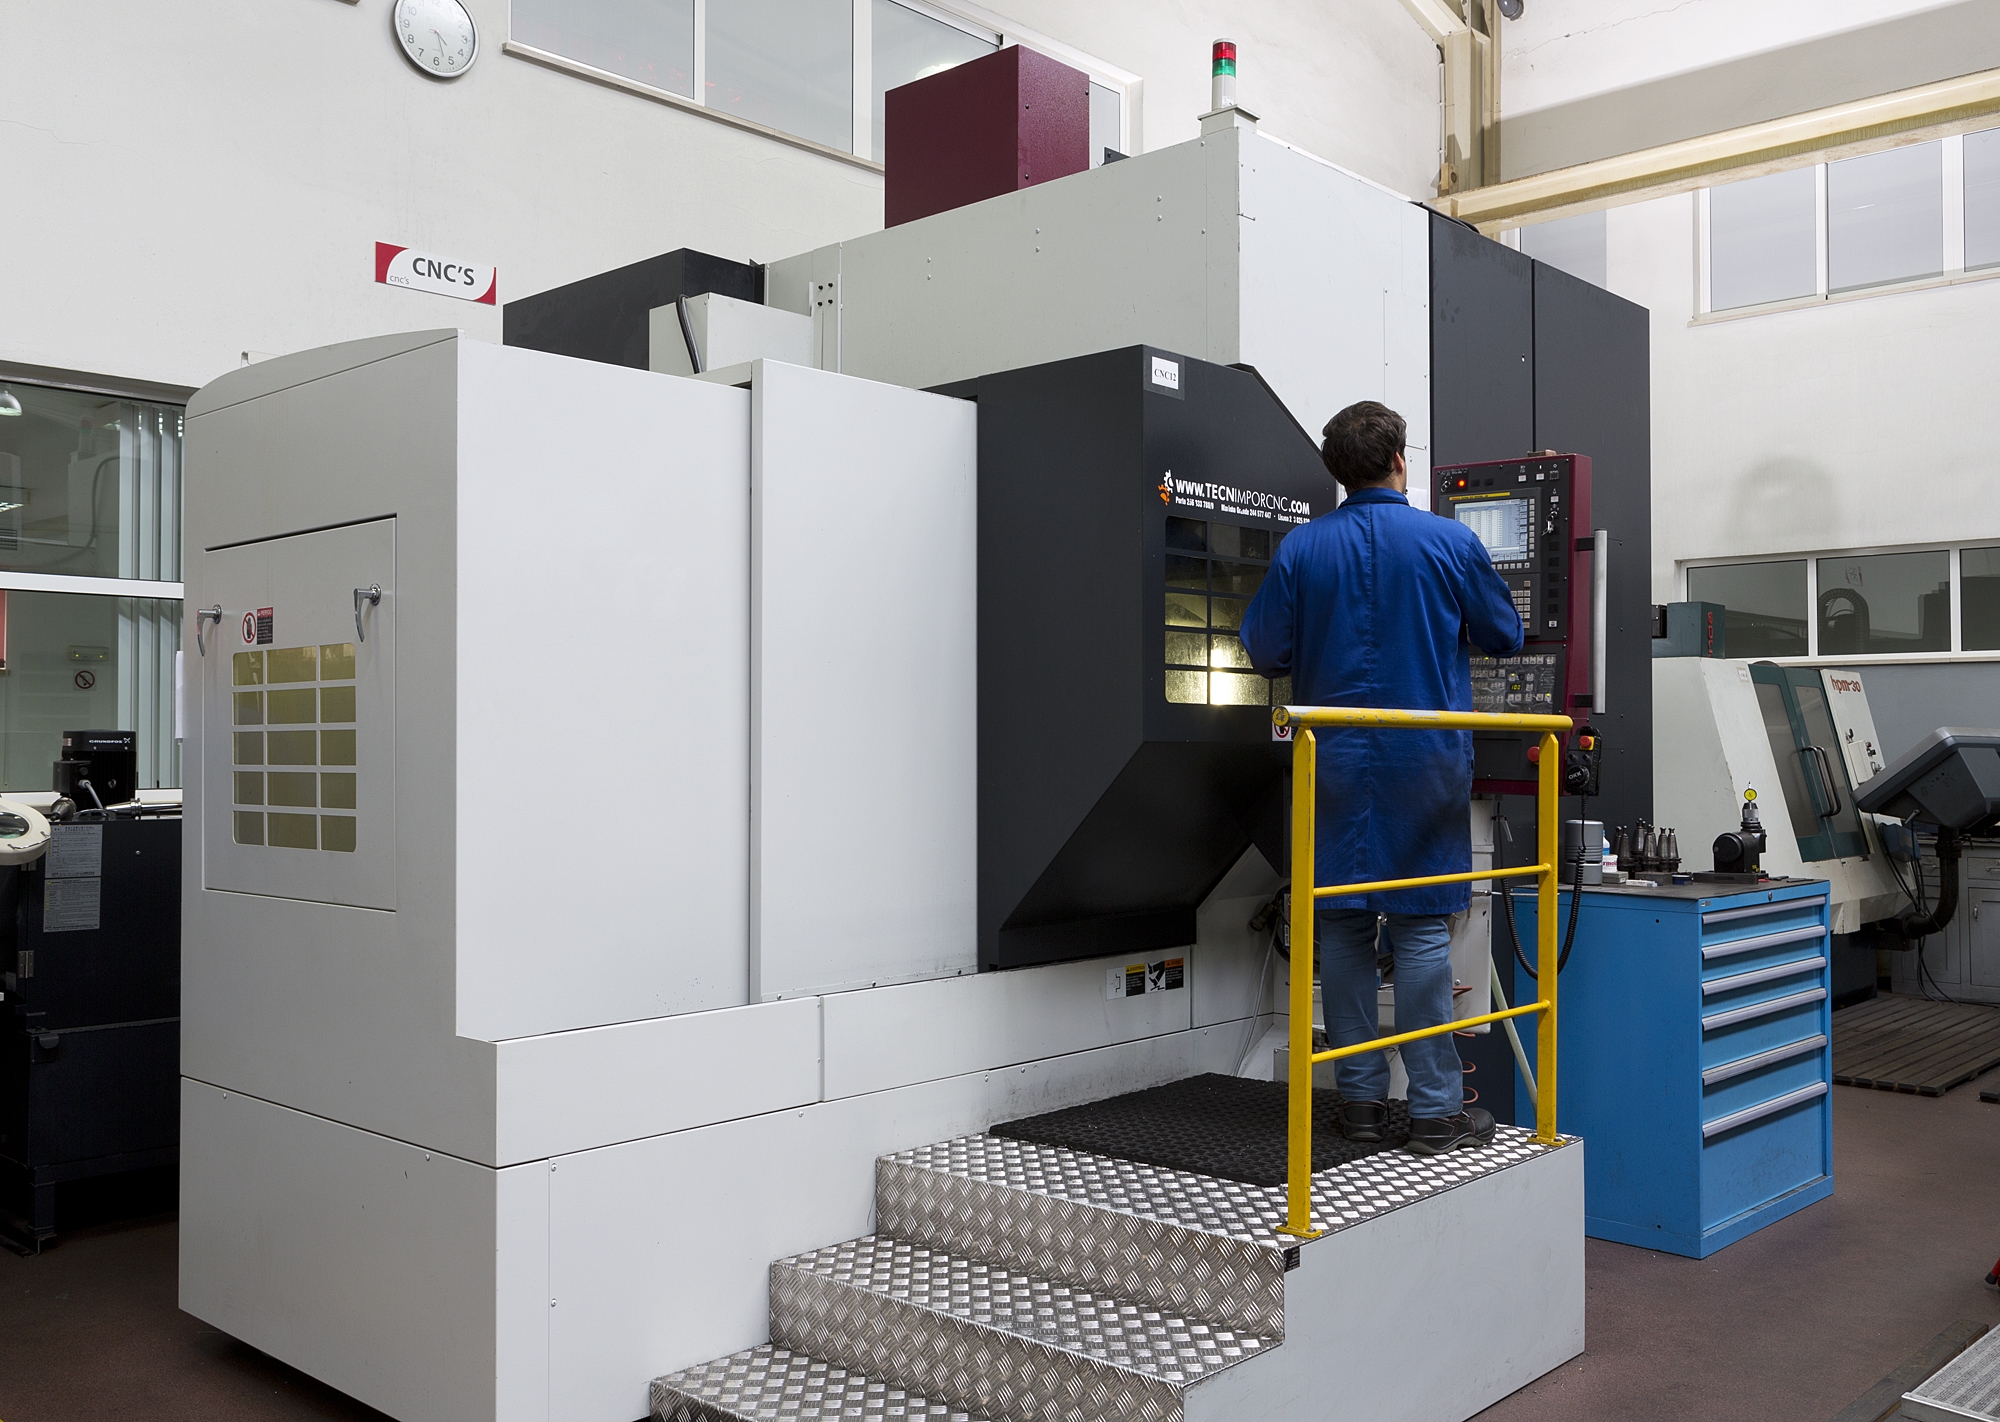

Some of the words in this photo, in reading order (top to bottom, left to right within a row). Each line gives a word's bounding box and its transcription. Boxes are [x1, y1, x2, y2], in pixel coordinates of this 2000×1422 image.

[407, 6, 417, 16] 10
[403, 19, 410, 28] 9
[407, 34, 415, 44] 8
[461, 35, 468, 44] 3
[418, 47, 425, 57] 7
[457, 48, 464, 57] 4
[433, 56, 440, 66] 6
[448, 56, 455, 65] 5
[412, 257, 475, 286] CNC'S
[1154, 368, 1177, 382] CNC12
[1175, 479, 1310, 516] WWW.TECNIMPORCNC.COM
[1175, 496, 1187, 506] Porto
[1568, 771, 1582, 780] OKK
